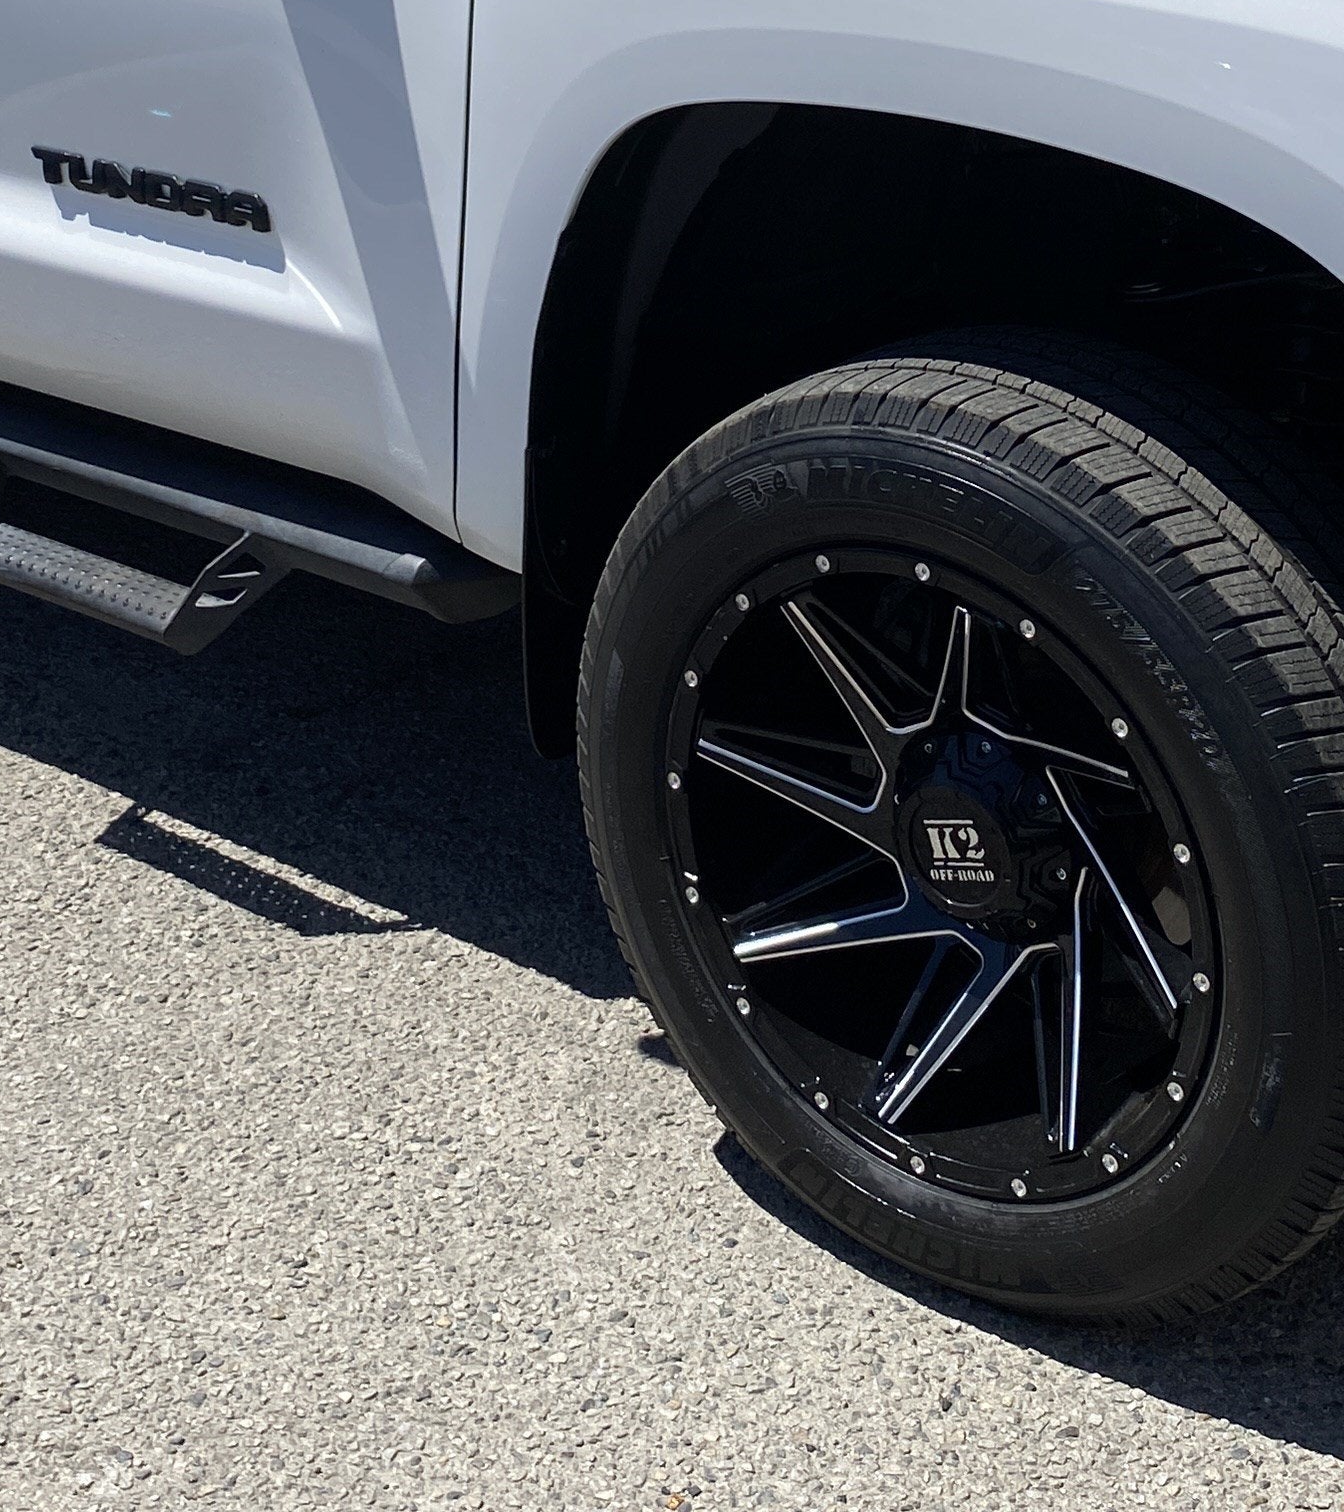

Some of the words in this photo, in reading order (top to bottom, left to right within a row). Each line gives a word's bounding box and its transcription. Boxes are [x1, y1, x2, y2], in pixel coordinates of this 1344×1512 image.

[31, 146, 272, 233] TUNDRA
[806, 458, 1068, 574] MICHELIN
[926, 826, 986, 859] K2
[930, 868, 996, 883] OFF-ROAD
